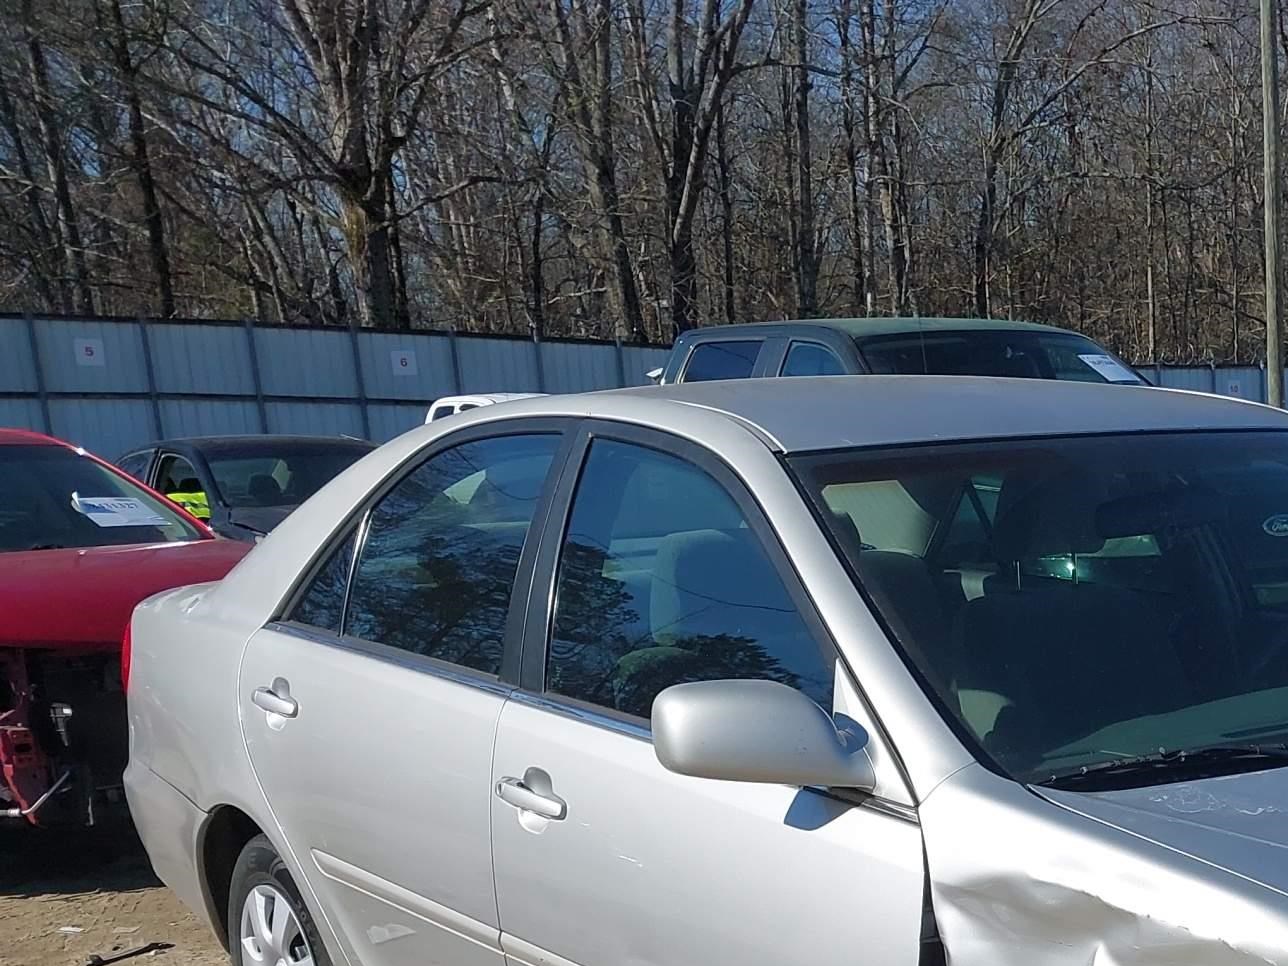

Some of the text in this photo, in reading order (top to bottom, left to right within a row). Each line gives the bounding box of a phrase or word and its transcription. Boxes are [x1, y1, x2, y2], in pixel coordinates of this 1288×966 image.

[84, 345, 95, 357] 5
[399, 356, 409, 368] 6
[1229, 383, 1240, 394] 10
